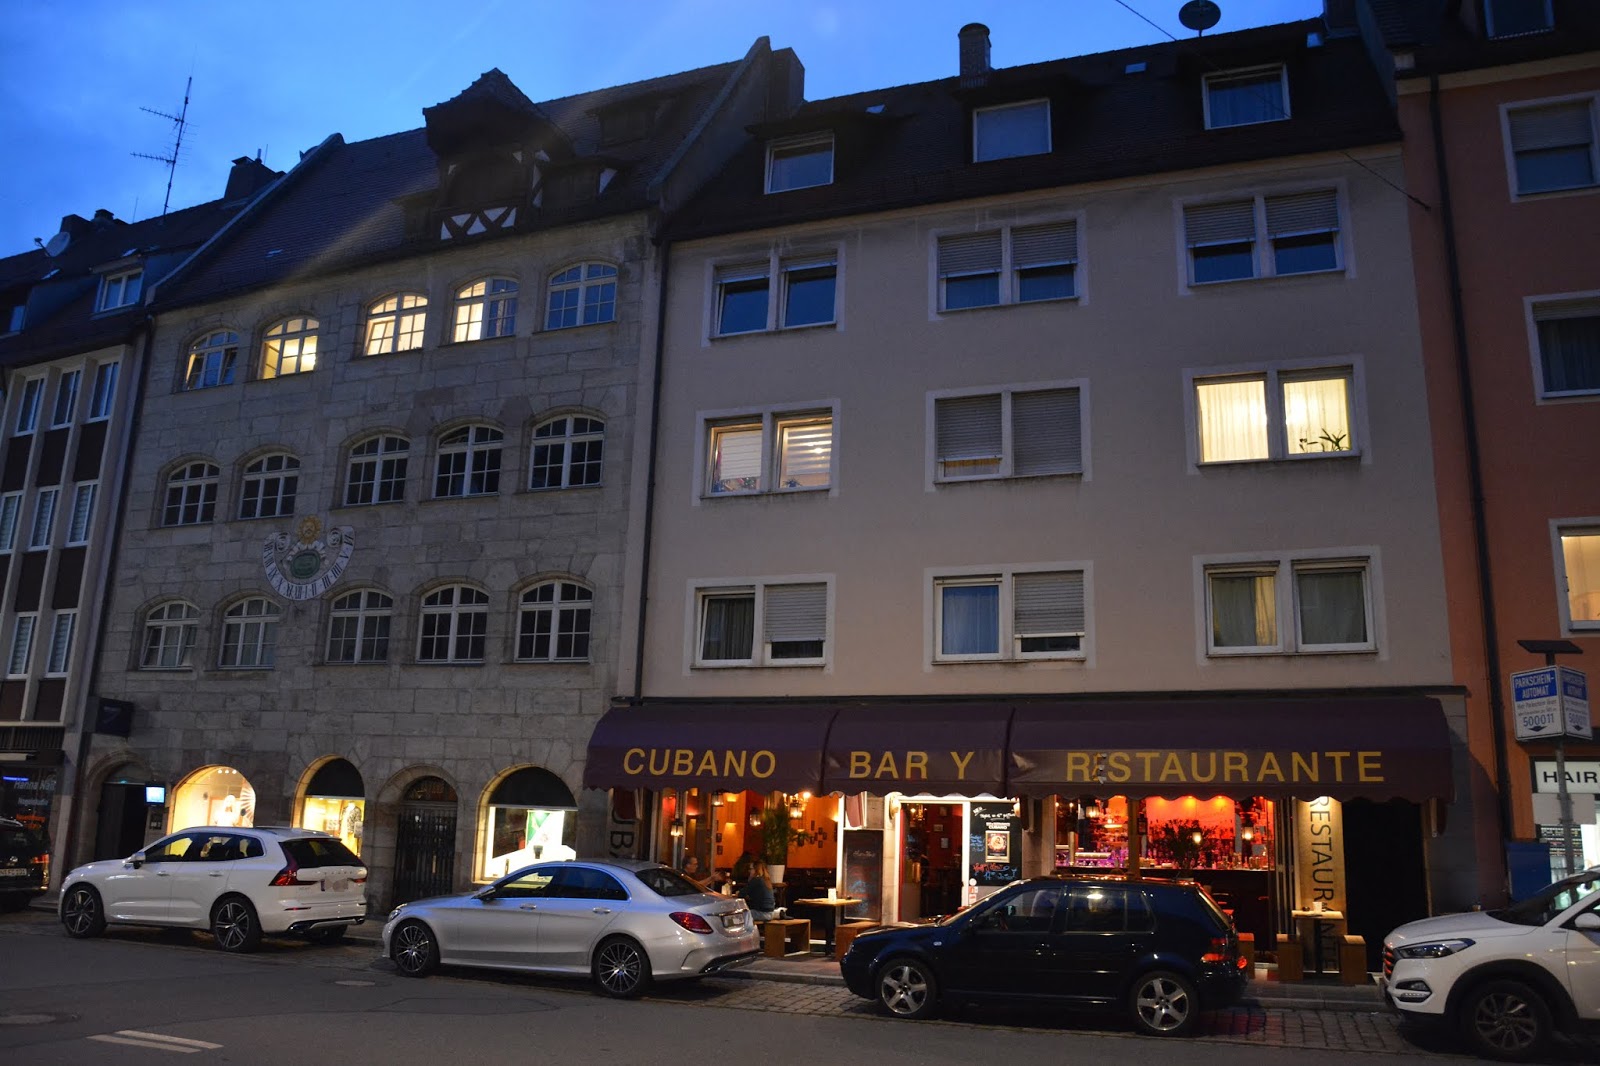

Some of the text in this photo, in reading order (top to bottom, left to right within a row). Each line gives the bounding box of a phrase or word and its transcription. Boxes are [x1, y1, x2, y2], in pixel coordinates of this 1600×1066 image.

[1515, 672, 1554, 689] PARKSCHEIN-
[1522, 685, 1549, 699] AUTOMAT
[1523, 713, 1555, 727] 500011
[623, 748, 776, 778] CUBANO
[850, 751, 929, 780] BAR
[950, 752, 974, 780] Y
[1543, 771, 1598, 783] HAIR
[1309, 797, 1337, 969] RESTAURNTE
